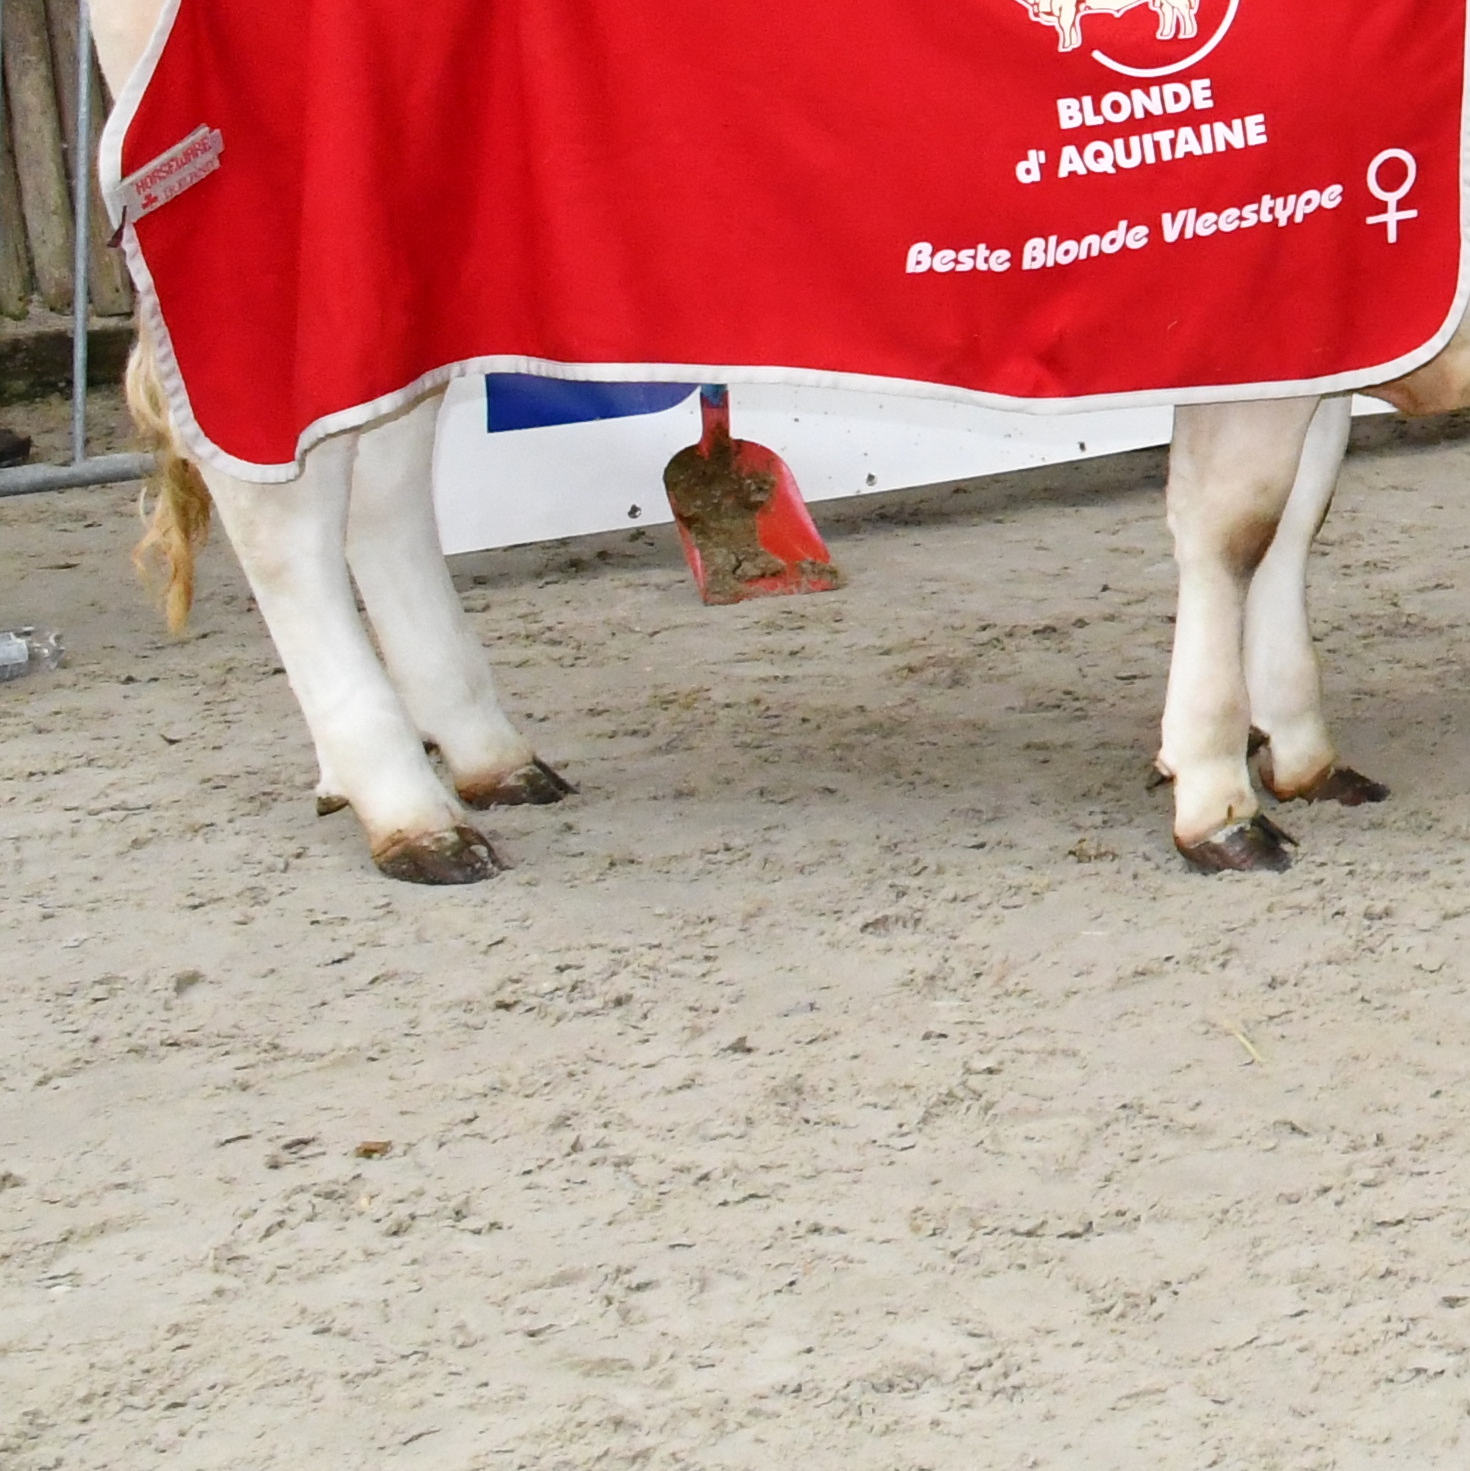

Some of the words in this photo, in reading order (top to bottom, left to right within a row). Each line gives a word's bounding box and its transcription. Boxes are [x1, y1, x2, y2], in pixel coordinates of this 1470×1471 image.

[1056, 79, 1214, 130] BLONDE
[134, 135, 212, 194] HORSEWARE
[1057, 114, 1268, 178] AQUITAINE
[905, 240, 1012, 274] Beste
[1021, 217, 1149, 270] Blonde
[1161, 182, 1344, 243] Vleestype
